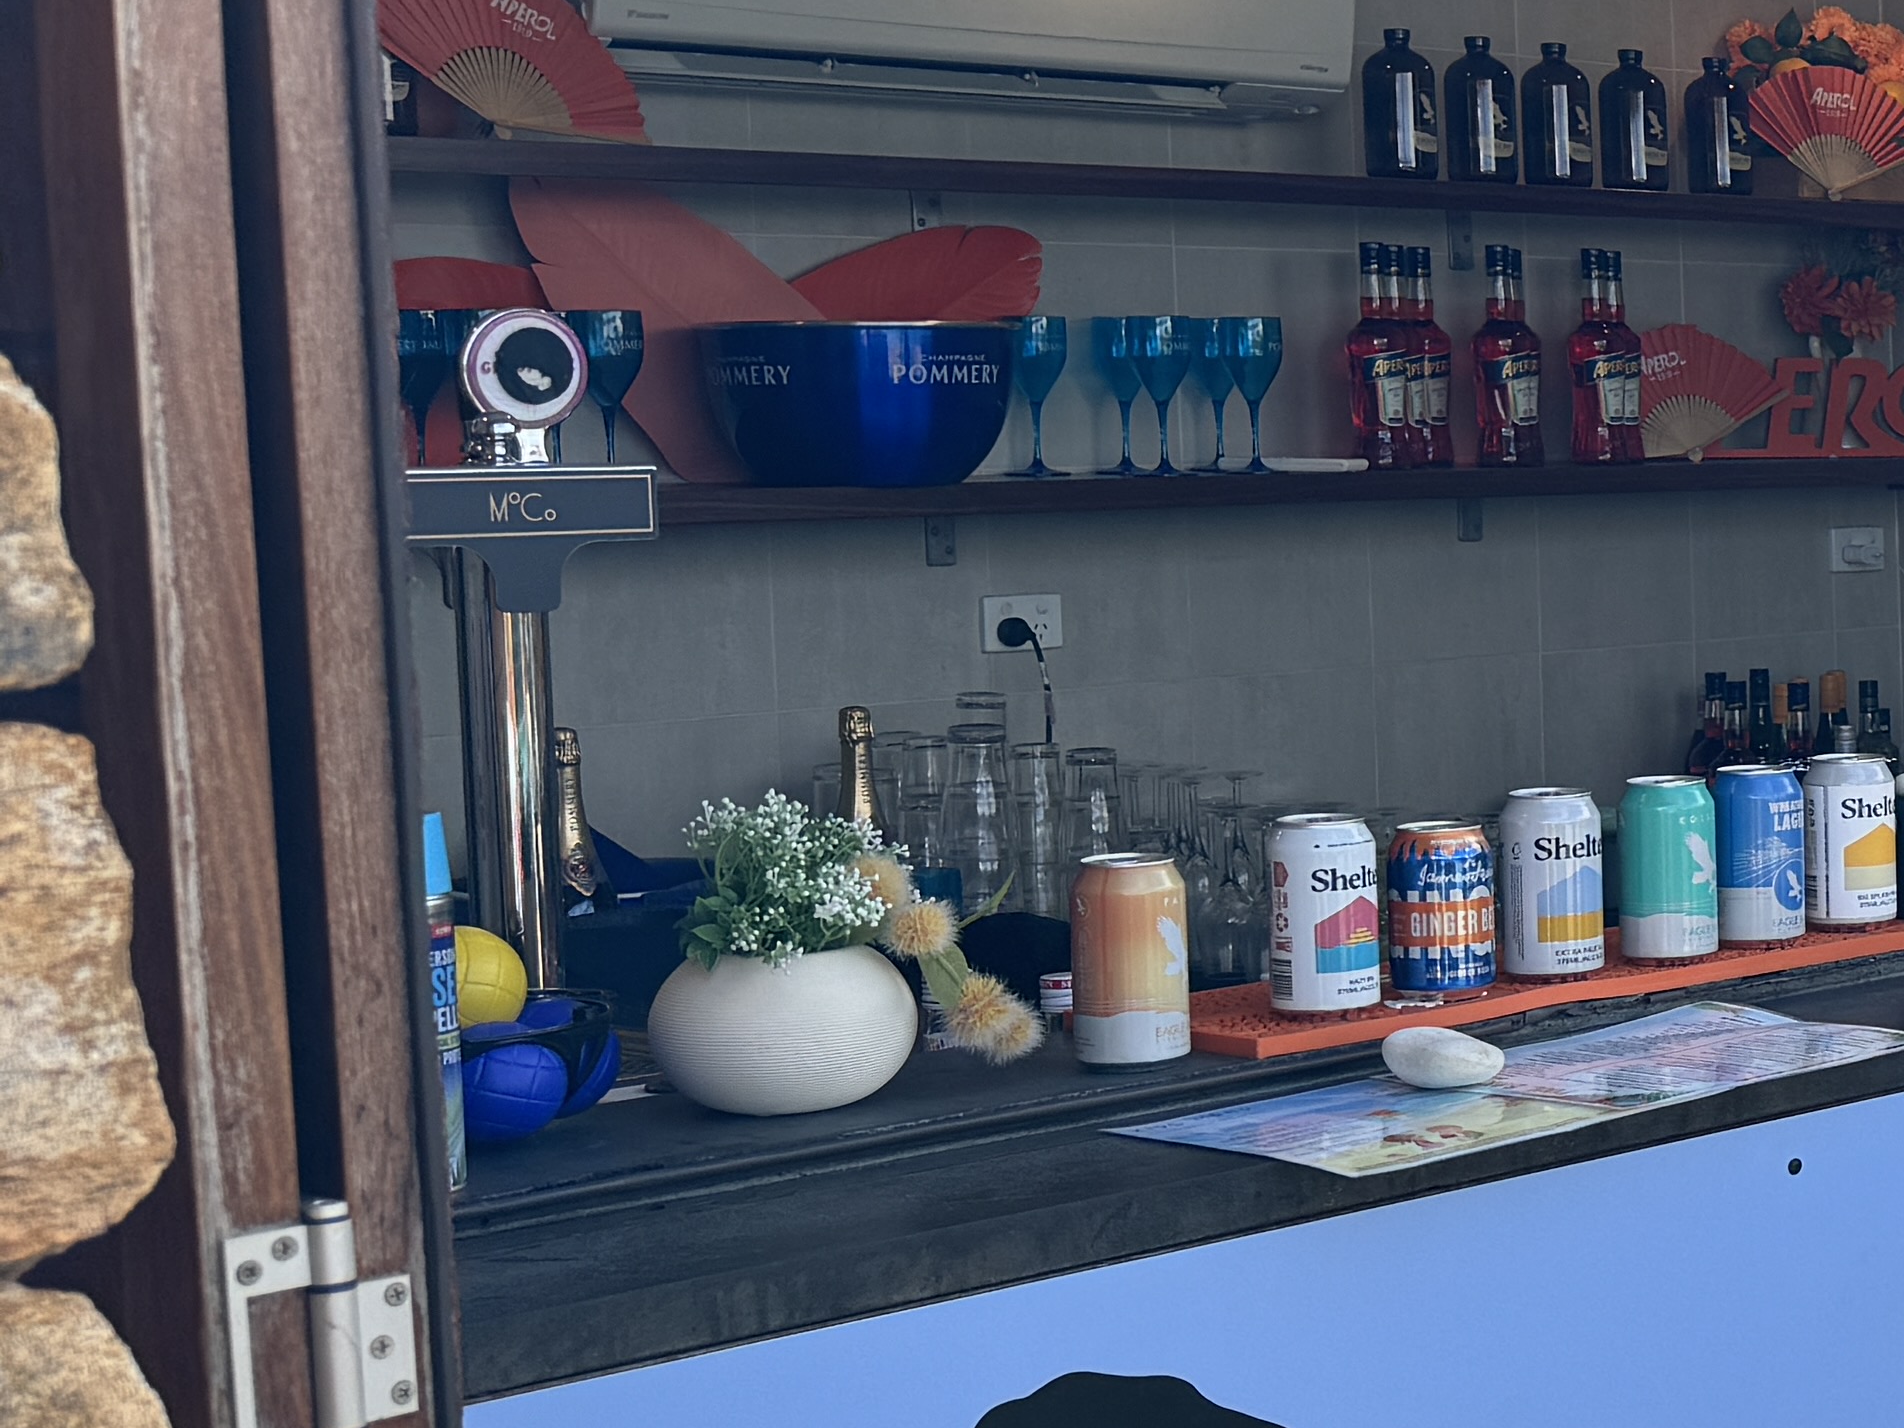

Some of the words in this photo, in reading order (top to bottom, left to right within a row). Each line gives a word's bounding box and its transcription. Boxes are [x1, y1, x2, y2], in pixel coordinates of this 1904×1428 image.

[1811, 87, 1858, 112] APEROL
[920, 353, 987, 363] CHAMPAGNE
[892, 363, 1000, 386] POMMERY
[1410, 909, 1479, 938] GINGER
